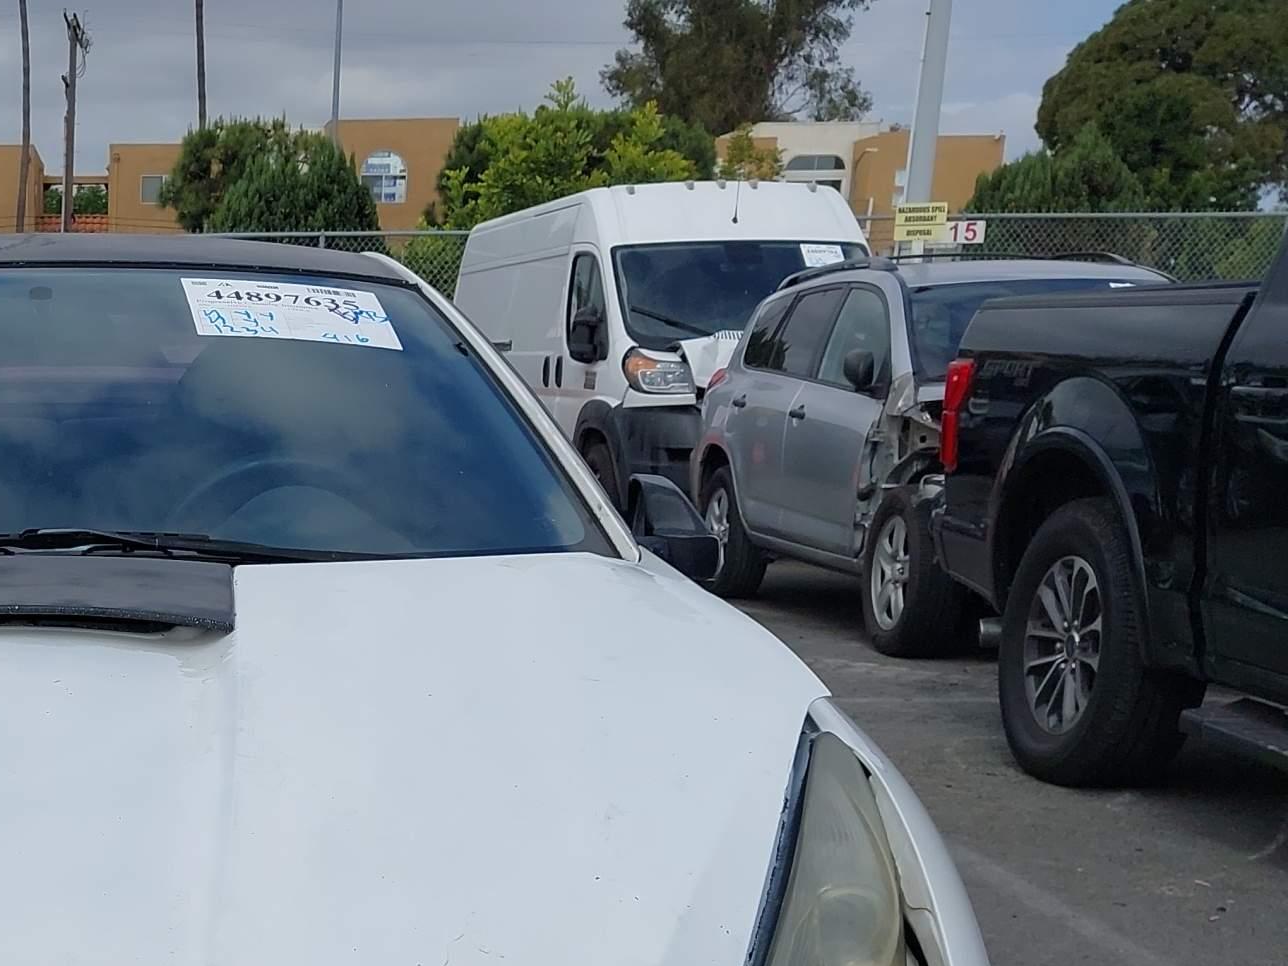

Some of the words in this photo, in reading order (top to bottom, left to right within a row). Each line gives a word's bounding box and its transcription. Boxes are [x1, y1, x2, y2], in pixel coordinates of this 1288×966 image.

[931, 205, 946, 213] SPILL
[949, 222, 978, 242] 15
[206, 288, 360, 311] 44897635
